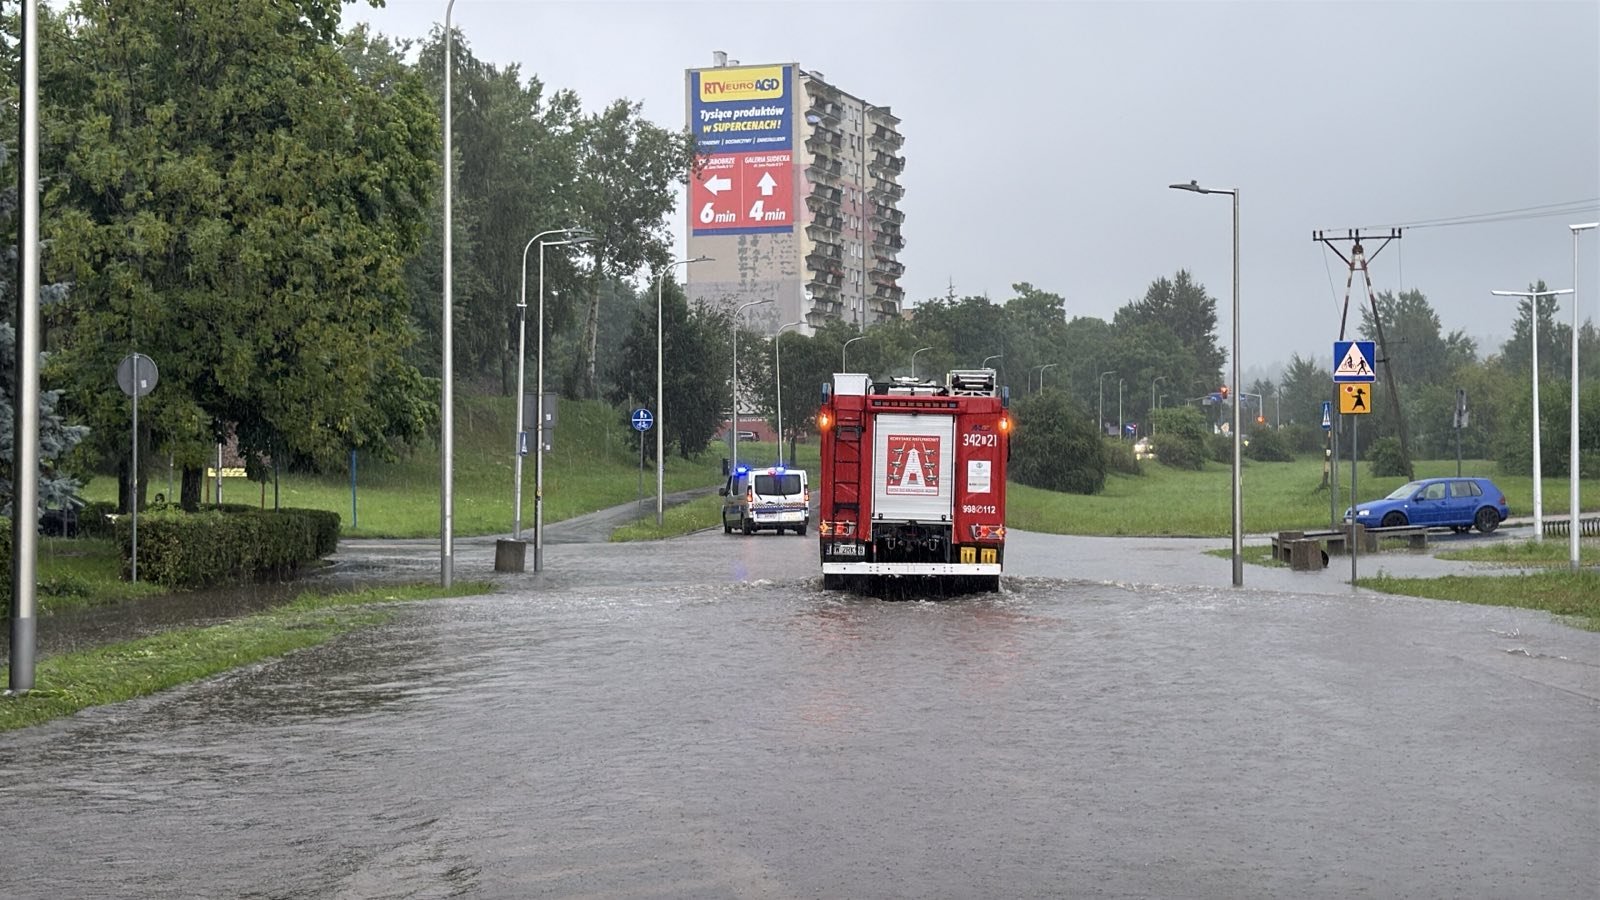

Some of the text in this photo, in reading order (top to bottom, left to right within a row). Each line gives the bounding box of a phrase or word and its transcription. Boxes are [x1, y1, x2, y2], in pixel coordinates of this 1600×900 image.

[704, 78, 780, 94] RTV EURO AGD
[700, 106, 784, 122] Tysiące produktów
[703, 120, 782, 133] w SUPERCENACH!
[744, 154, 790, 164] GALERIA SUDECKA
[700, 202, 736, 224] 6 min
[749, 200, 786, 221] 4 min
[963, 433, 997, 447] 342 21
[962, 505, 996, 514] 998 112
